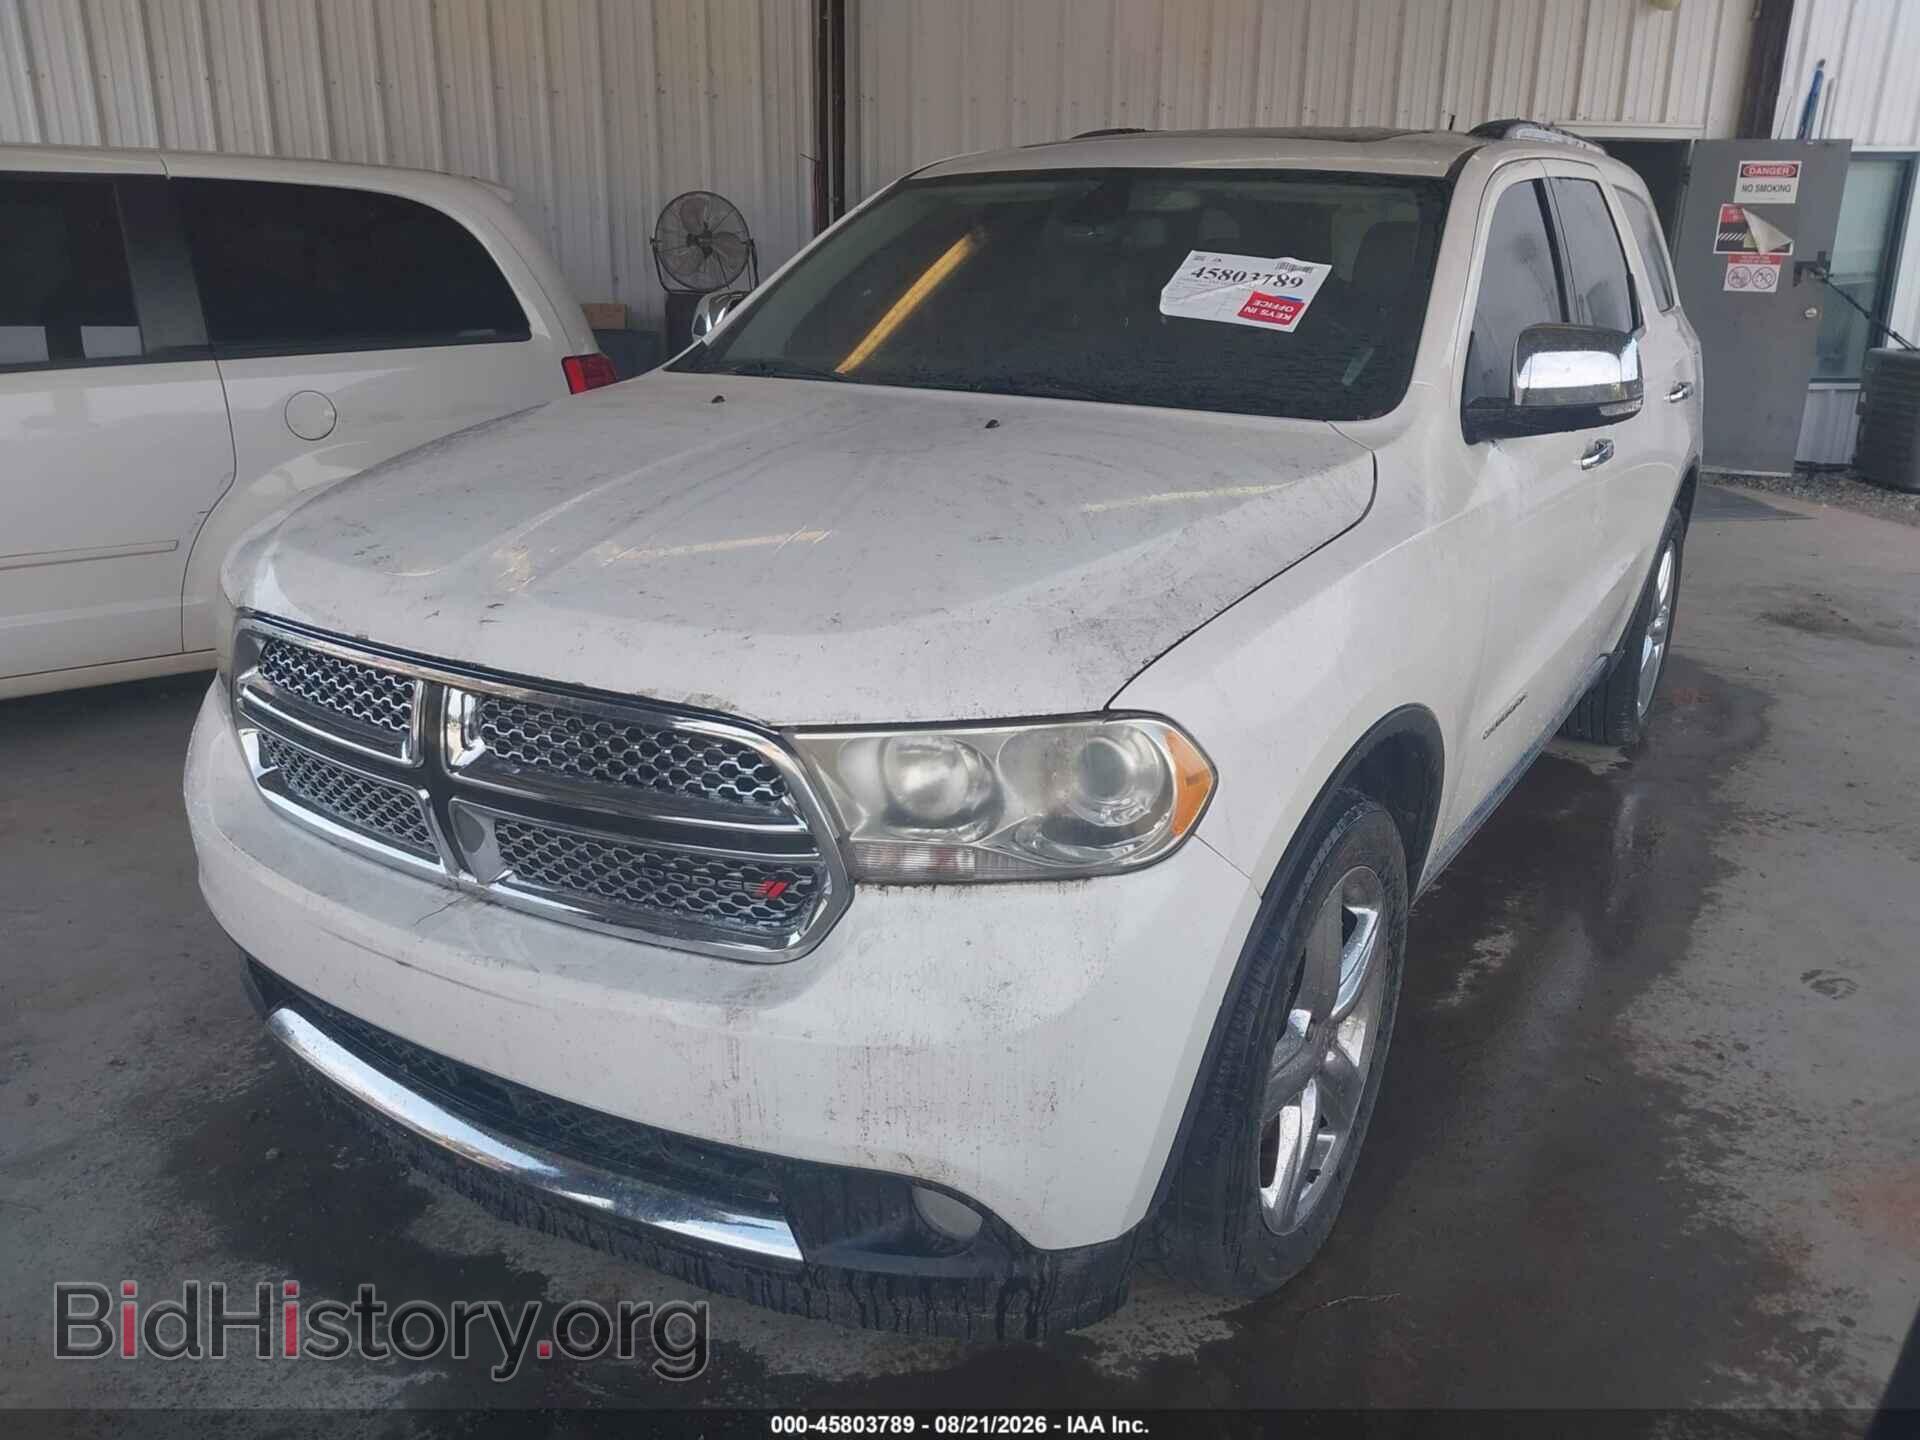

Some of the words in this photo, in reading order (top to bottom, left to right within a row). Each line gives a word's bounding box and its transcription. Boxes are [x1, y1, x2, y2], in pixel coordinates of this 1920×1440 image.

[1748, 166, 1790, 175] DANGER
[1741, 184, 1753, 192] NO
[1755, 184, 1792, 193] SMOKING
[1191, 266, 1304, 289] 45803789
[1244, 306, 1258, 315] IN
[1253, 300, 1295, 313] OFFICE
[1261, 309, 1292, 321] KEYS
